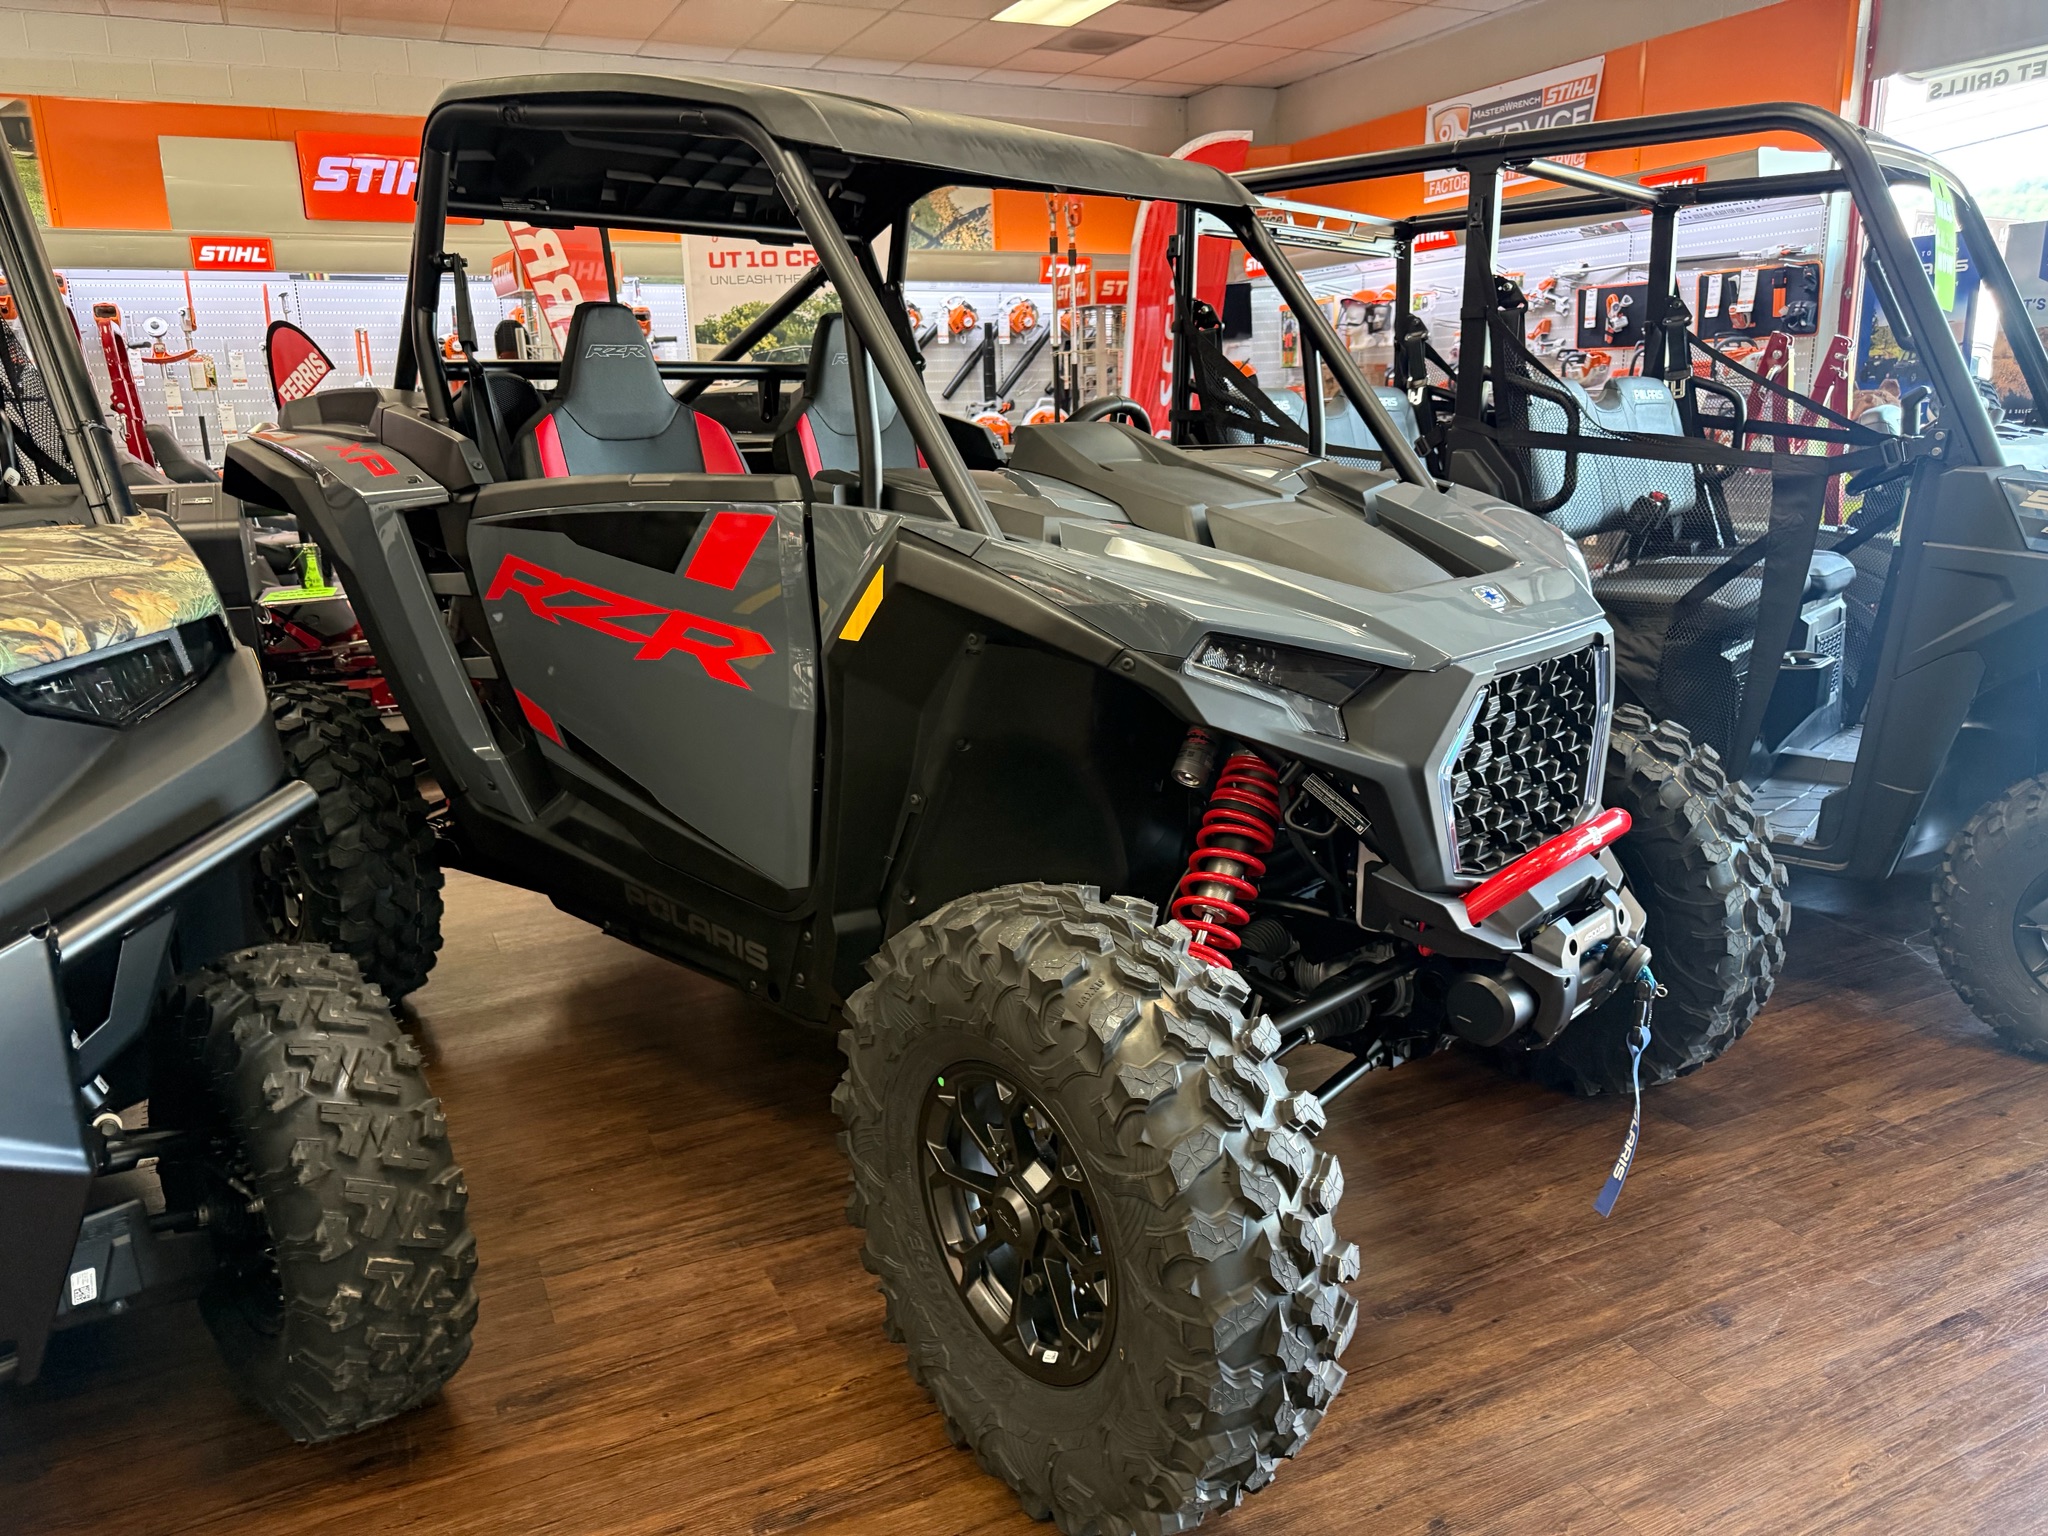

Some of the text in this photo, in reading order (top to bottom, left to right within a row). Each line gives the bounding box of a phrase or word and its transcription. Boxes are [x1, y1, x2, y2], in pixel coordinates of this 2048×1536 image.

[1545, 77, 1594, 105] STIHL
[1429, 177, 1468, 196] FACTOR
[199, 245, 267, 263] STIHL
[710, 274, 773, 285] UNLEASH
[585, 344, 647, 359] RZR
[278, 352, 328, 402] FERRIS
[324, 442, 400, 478] XP
[485, 553, 776, 691] RZR
[624, 881, 769, 971] POLARIS
